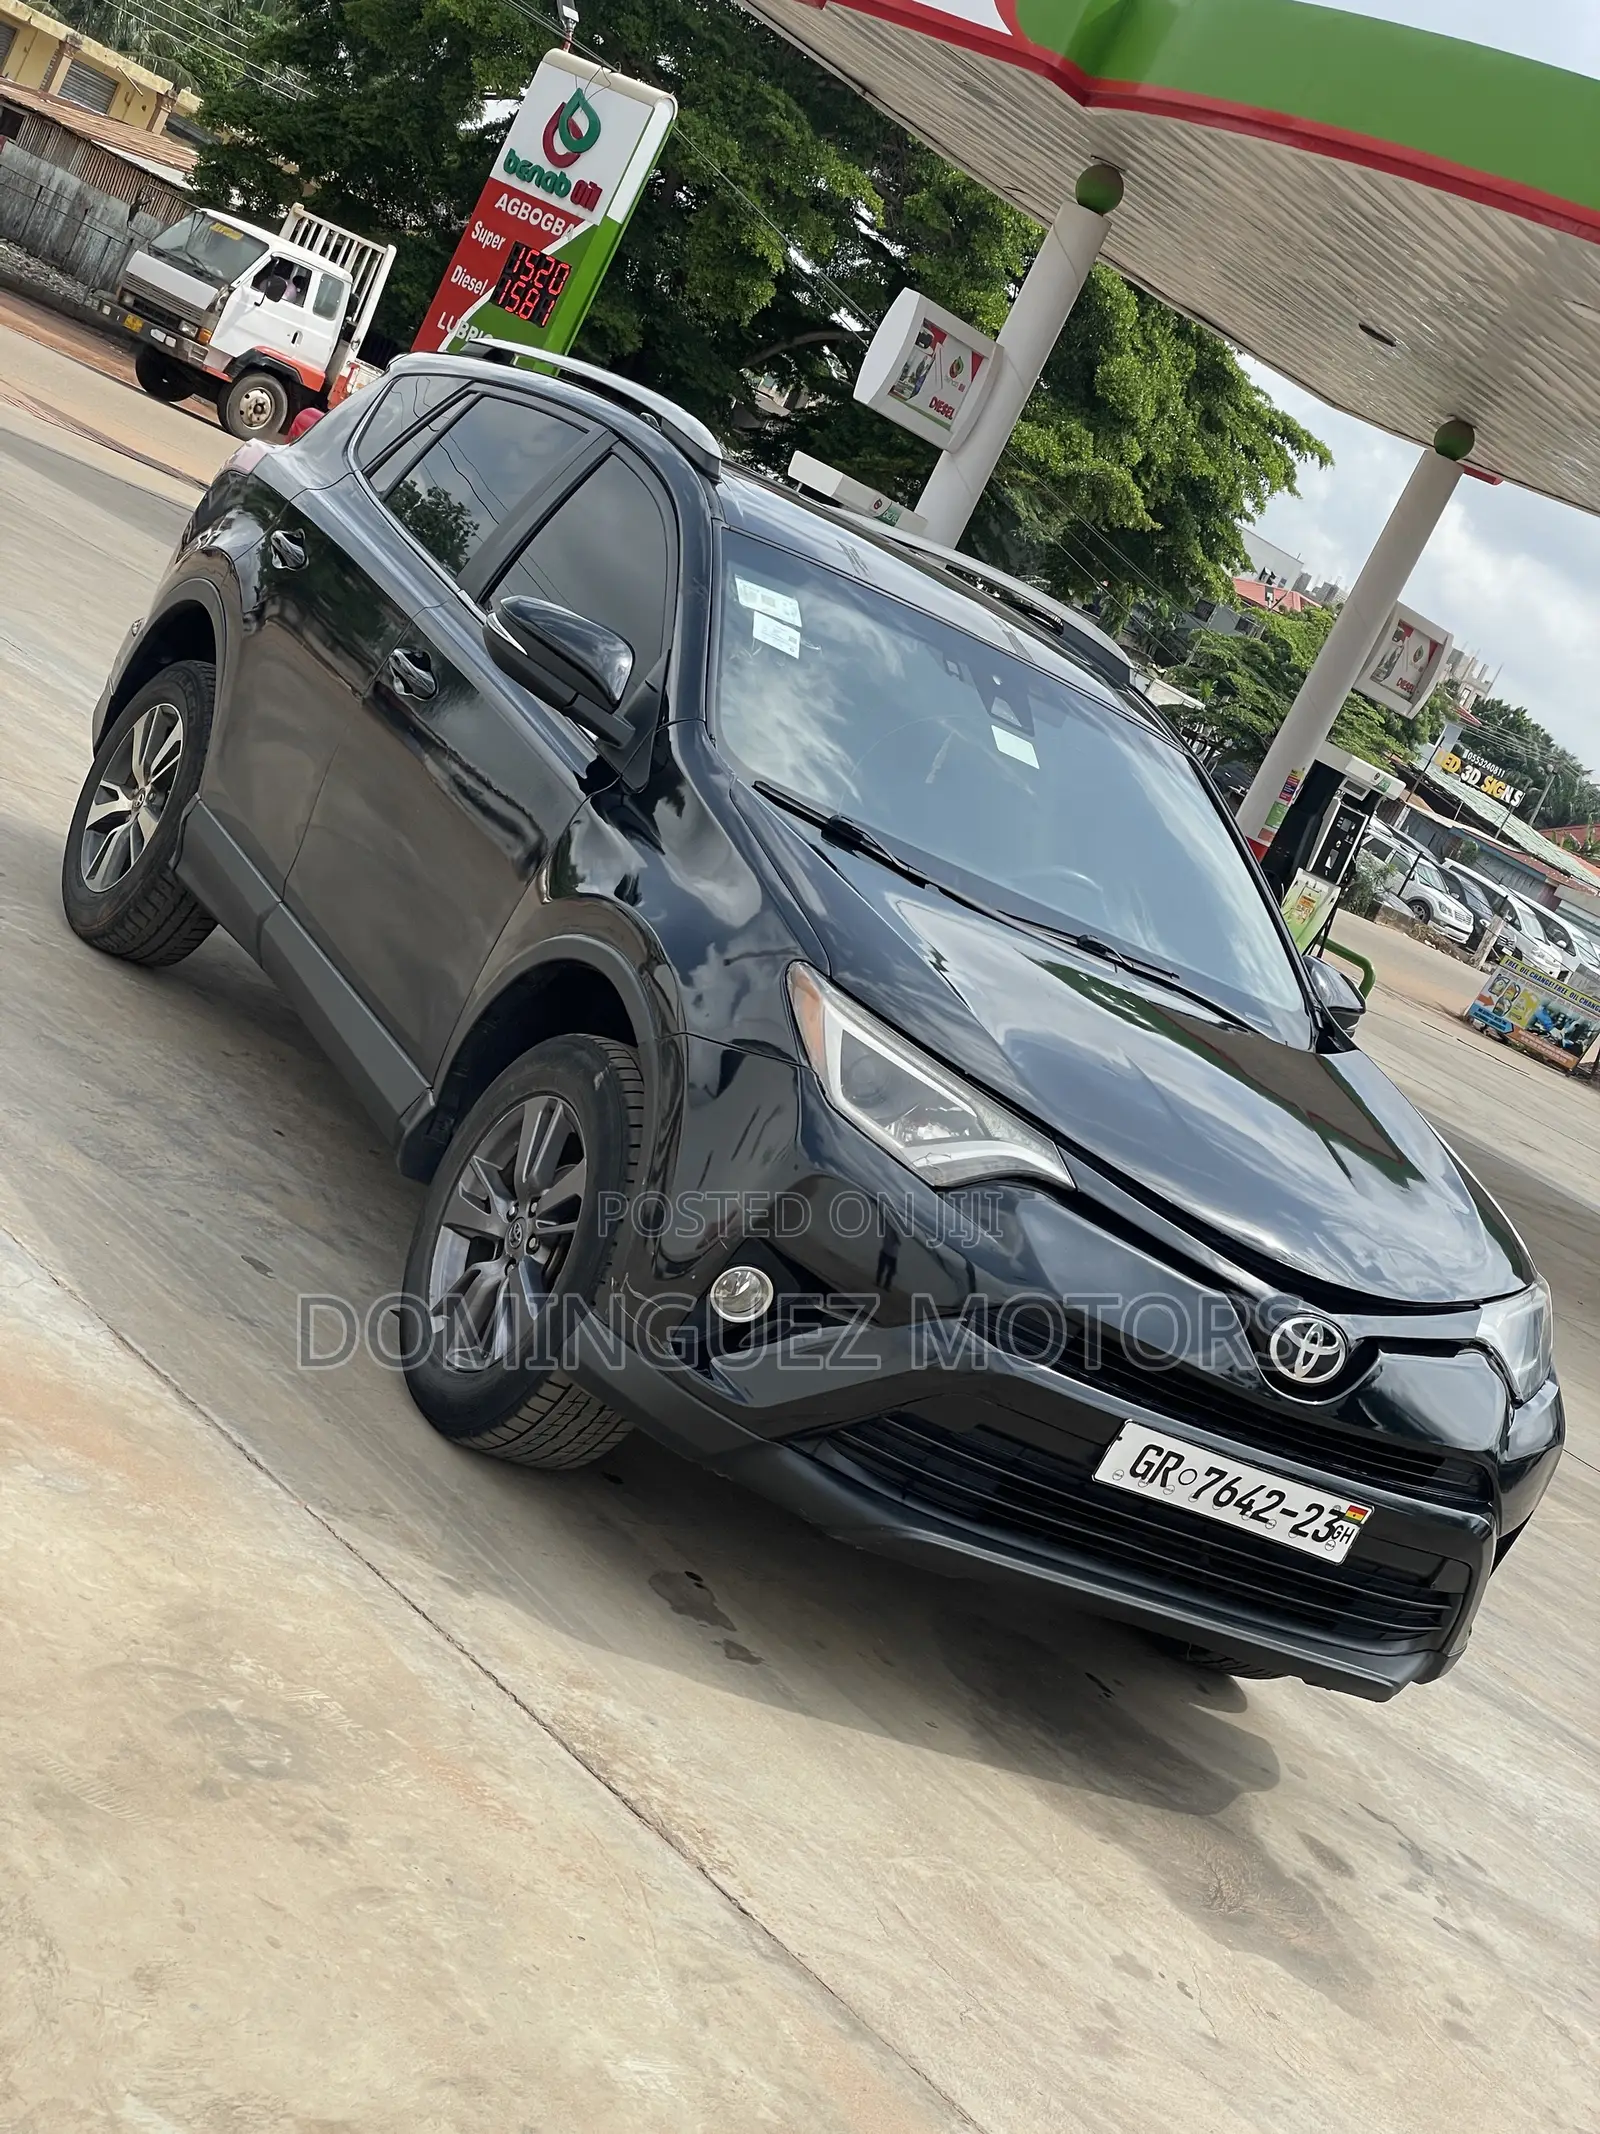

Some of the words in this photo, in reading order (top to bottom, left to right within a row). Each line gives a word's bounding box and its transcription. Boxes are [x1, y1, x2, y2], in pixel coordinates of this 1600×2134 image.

[494, 193, 575, 241] AGBOGBA
[471, 220, 506, 250] Super
[450, 264, 489, 296] Diesel
[437, 311, 493, 342] LUBRI
[928, 396, 956, 420] DIESEL
[1460, 765, 1481, 786] 3D
[1480, 775, 1525, 807] SIGNS
[1129, 1444, 1185, 1488] GR
[1331, 1524, 1356, 1544] GH
